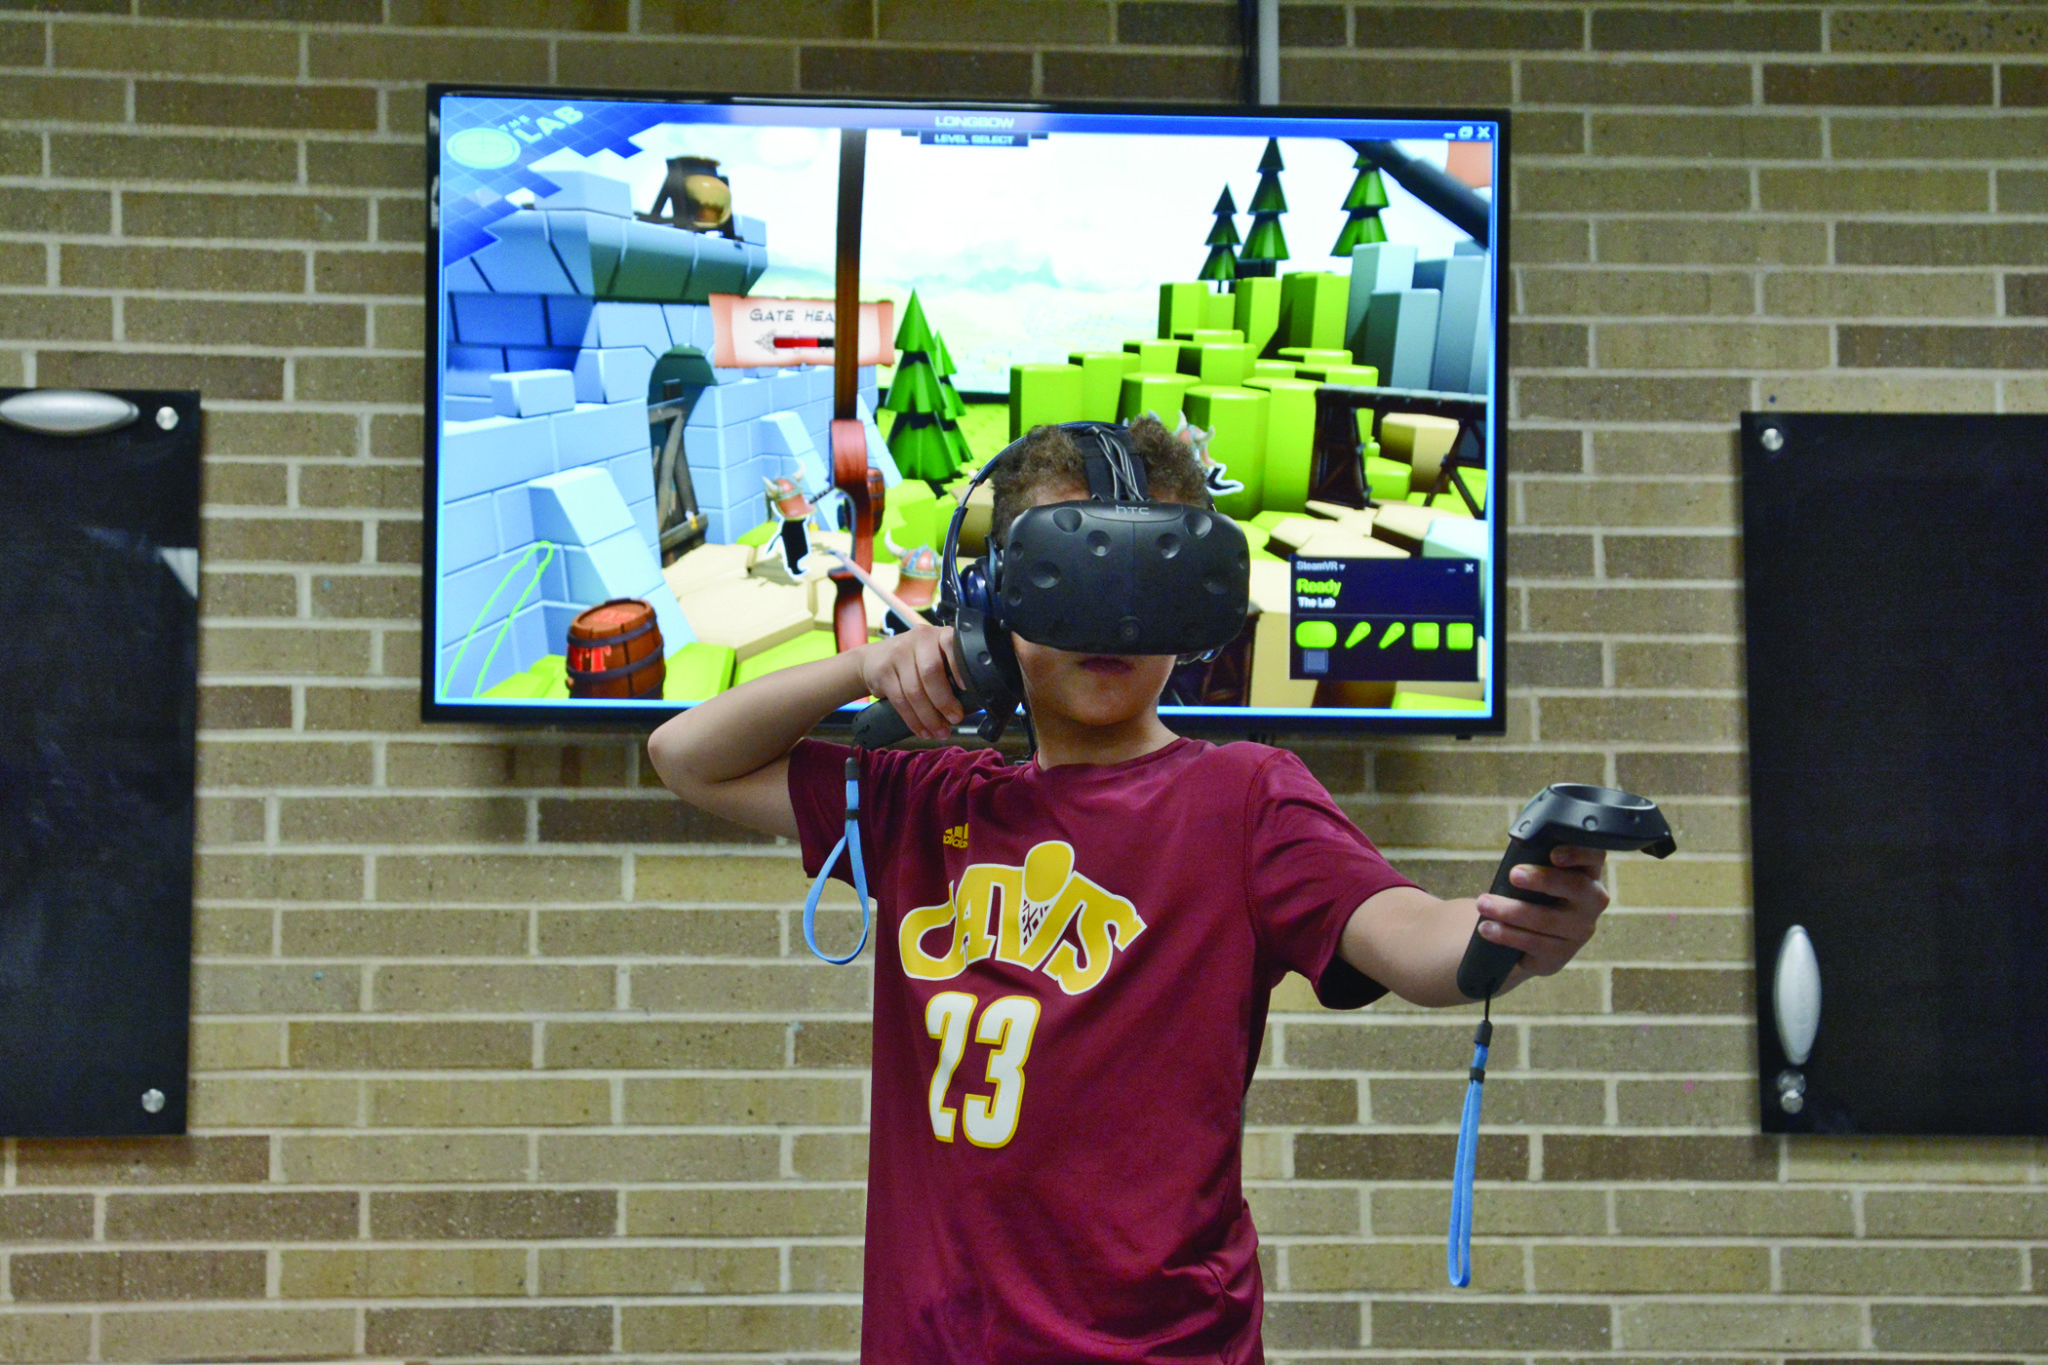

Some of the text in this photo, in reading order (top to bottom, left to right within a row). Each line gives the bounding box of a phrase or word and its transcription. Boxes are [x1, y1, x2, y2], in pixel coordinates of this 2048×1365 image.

[513, 106, 584, 145] LAB
[935, 115, 1015, 129] LONGBOW
[934, 133, 1015, 145] LEVEL SELECT
[750, 308, 836, 323] GATE HEA
[1296, 560, 1338, 572] SteamVR
[1296, 578, 1342, 597] Ready
[1297, 596, 1337, 608] The Lab
[899, 856, 1148, 996] CAVS
[925, 991, 1042, 1149] 23
